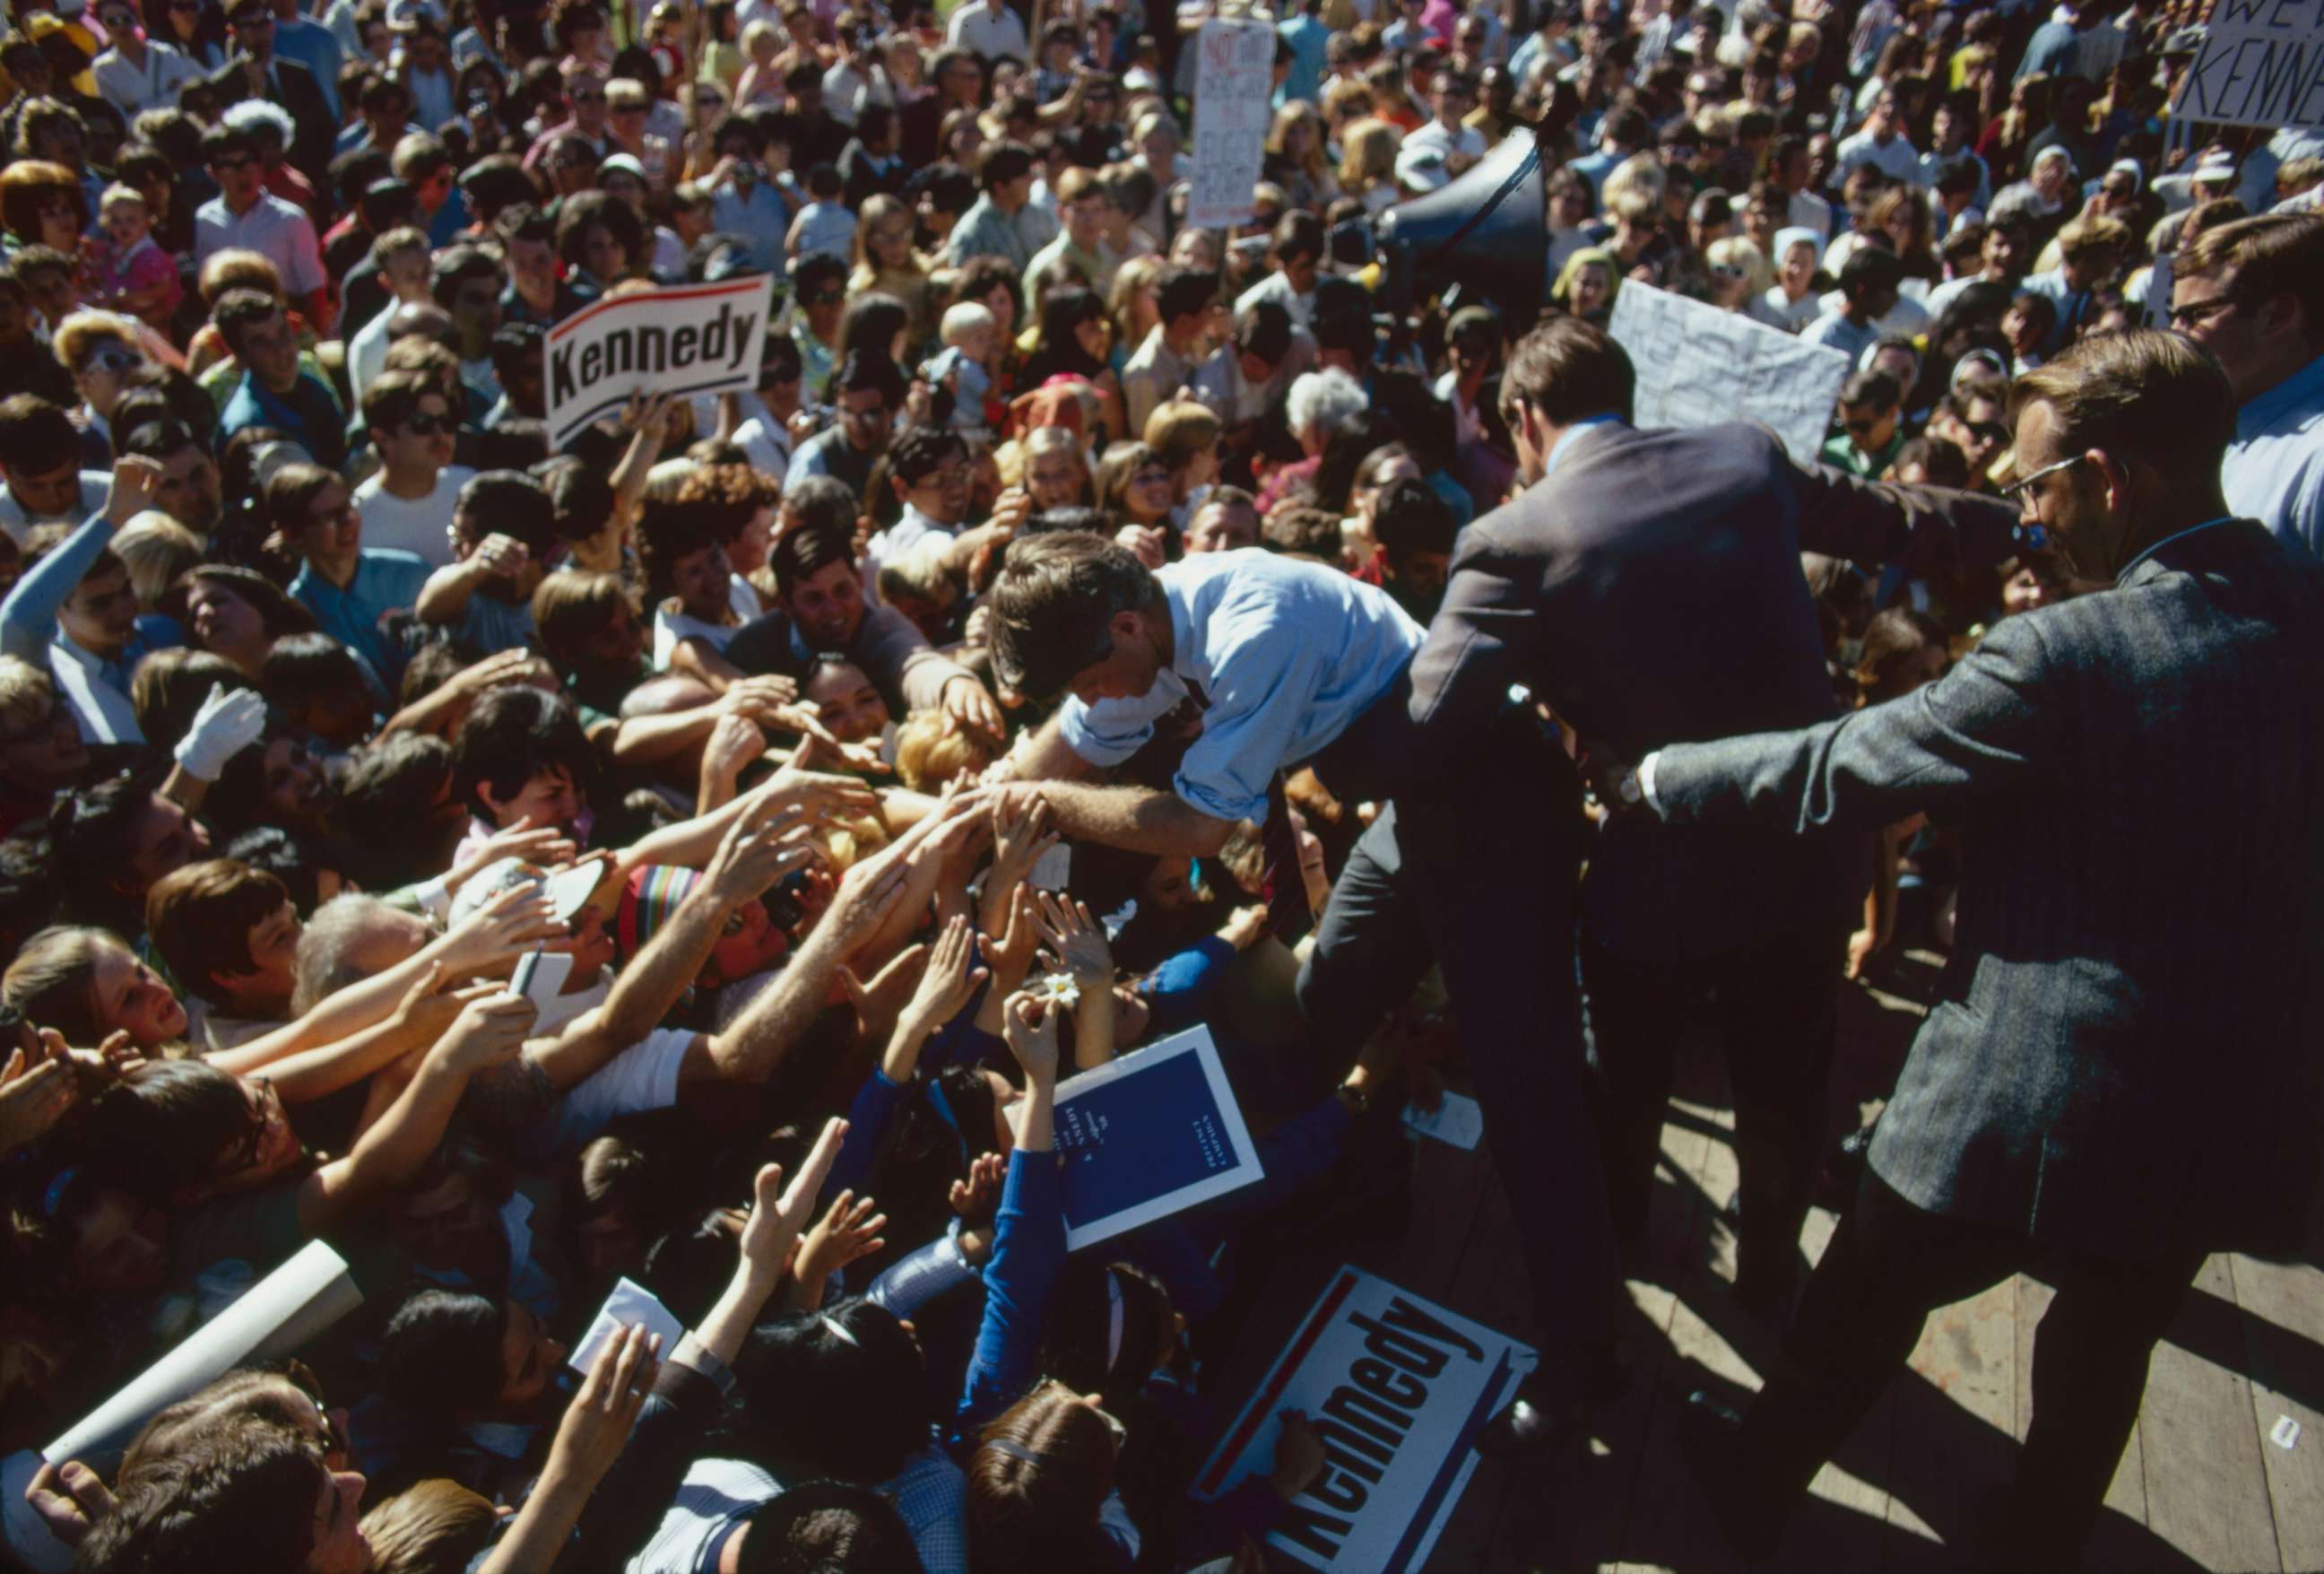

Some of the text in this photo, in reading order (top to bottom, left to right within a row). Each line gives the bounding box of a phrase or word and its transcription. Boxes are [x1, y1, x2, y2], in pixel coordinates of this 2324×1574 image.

[2176, 36, 2324, 125] KENNE
[551, 302, 757, 409] Kennedy
[1065, 1106, 1093, 1163] KNNEDY
[1202, 1115, 1227, 1165] CAMPAIGN
